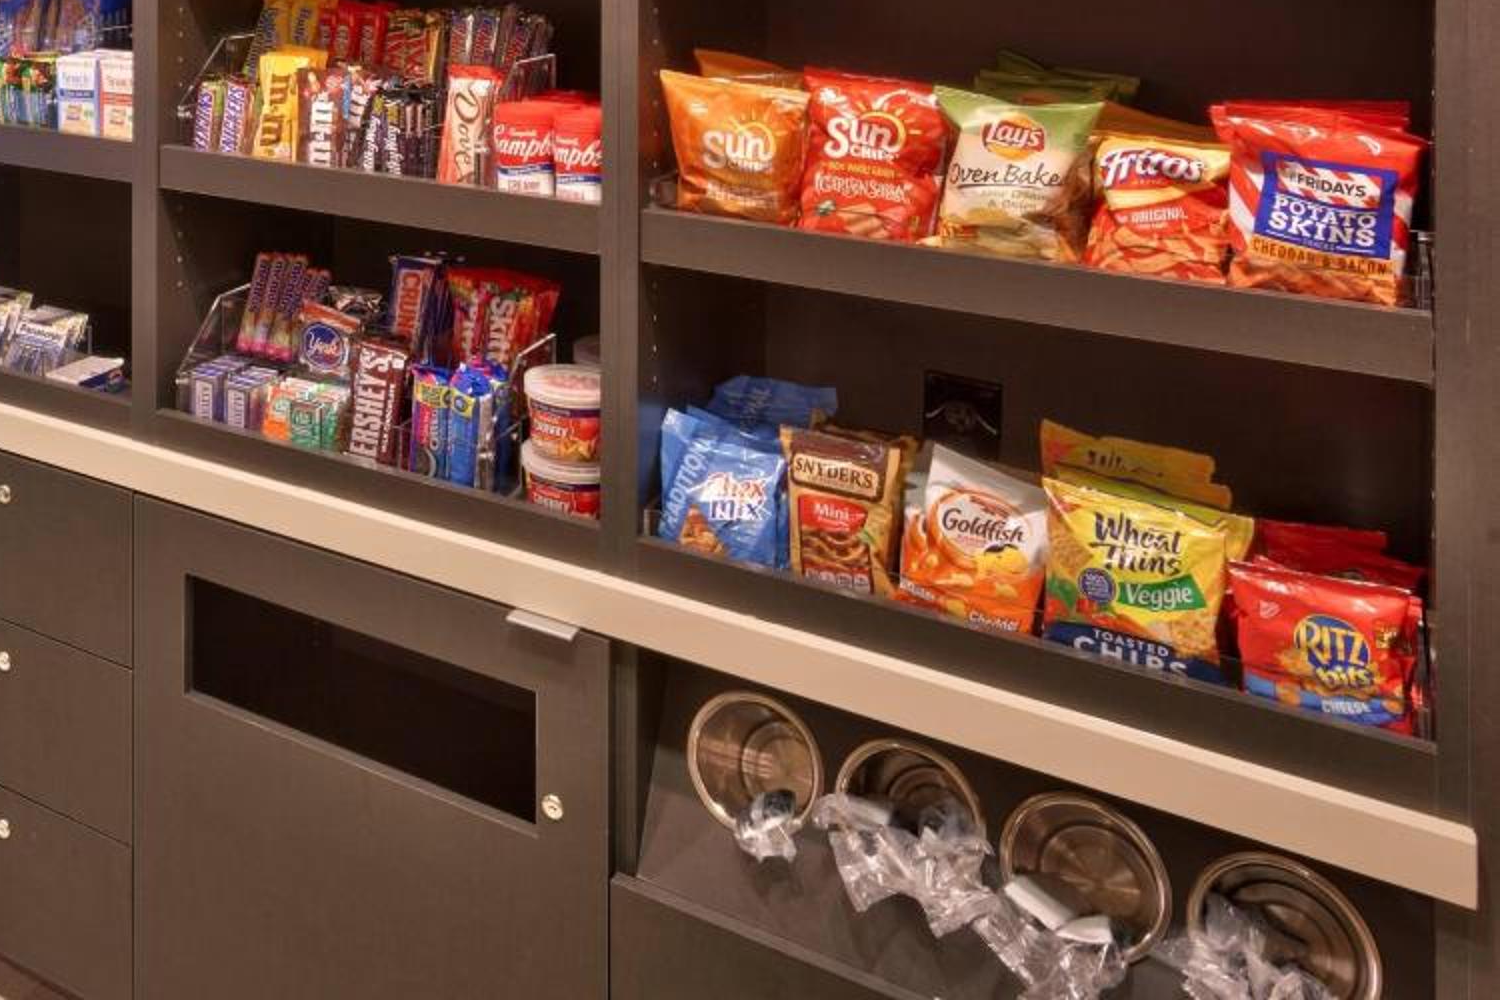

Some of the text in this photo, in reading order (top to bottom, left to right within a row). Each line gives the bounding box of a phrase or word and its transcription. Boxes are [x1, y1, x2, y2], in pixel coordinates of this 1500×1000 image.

[453, 85, 480, 178] Dove
[703, 130, 774, 168] Sun
[824, 117, 901, 159] Sun
[985, 123, 1044, 148] Lay's
[949, 163, 1062, 186] Oven Bake
[1297, 174, 1366, 197] FRIDAYS
[1272, 192, 1377, 229] POTATO
[1268, 211, 1376, 247] SKINS
[795, 457, 874, 489] SNYDER'S
[814, 502, 849, 520] Mini
[942, 508, 1024, 543] Goldfish
[1094, 512, 1182, 554] Wheat
[1089, 542, 1182, 575] Thins
[1125, 583, 1194, 611] Veggie
[1073, 635, 1187, 674] CHIPS
[1093, 629, 1169, 657] TOASTED
[1299, 622, 1364, 666] RITZ
